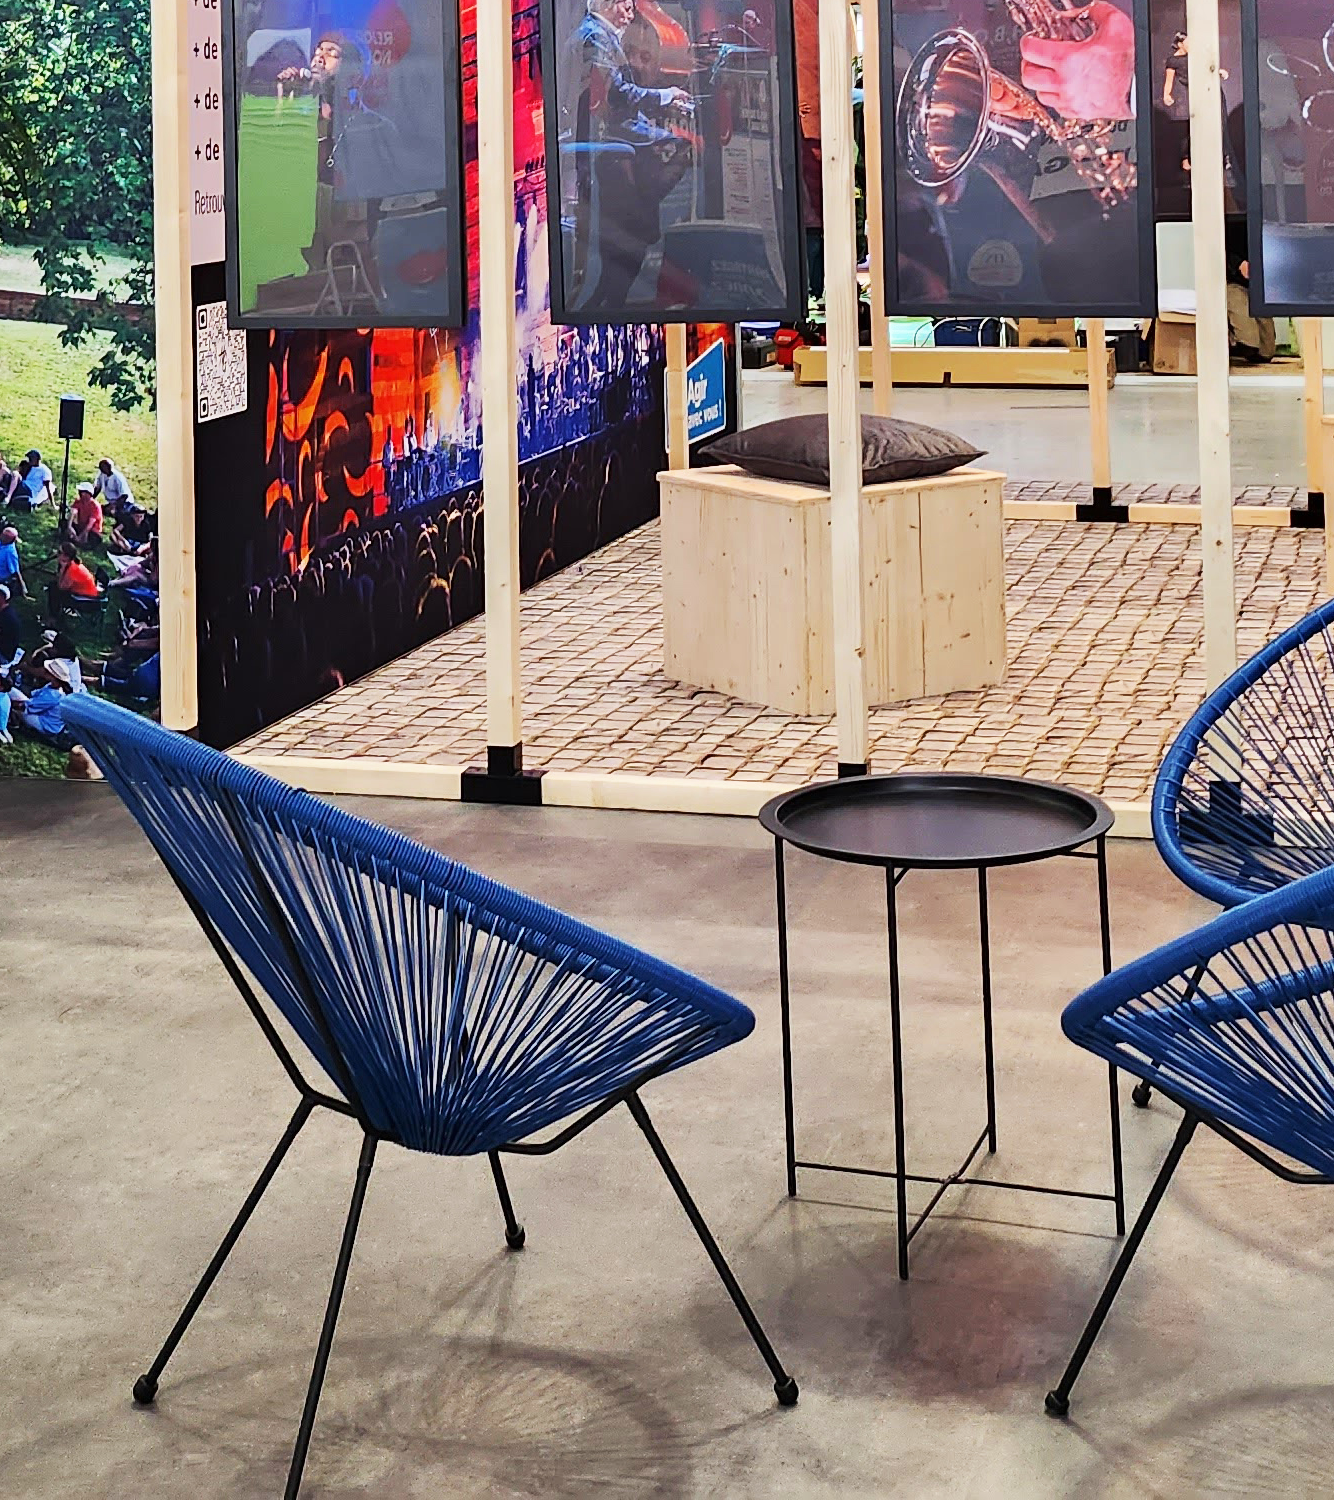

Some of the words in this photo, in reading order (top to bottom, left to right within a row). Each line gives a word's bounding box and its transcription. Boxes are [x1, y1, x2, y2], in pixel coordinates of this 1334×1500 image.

[203, 36, 218, 60] de
[204, 87, 219, 110] de
[205, 138, 220, 161] de
